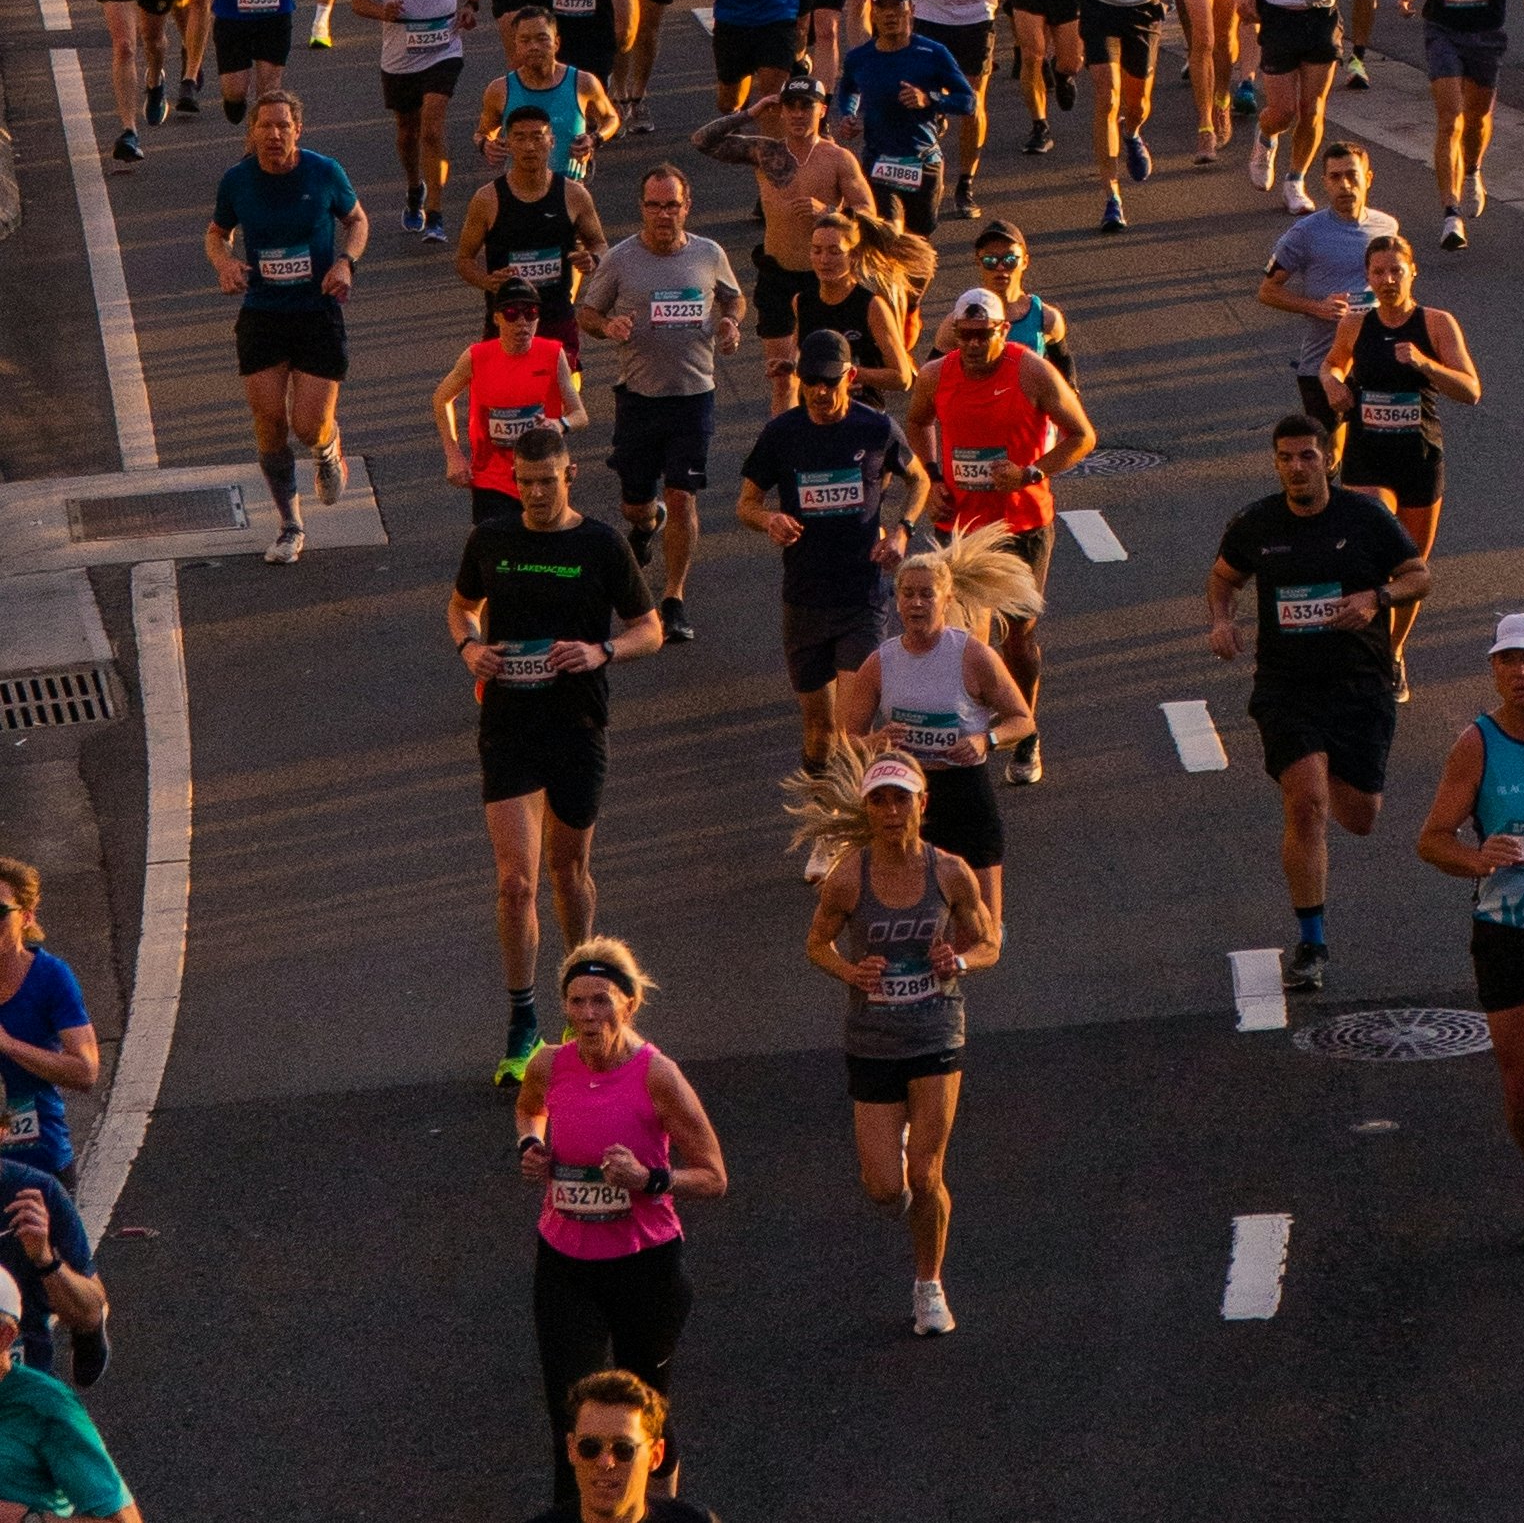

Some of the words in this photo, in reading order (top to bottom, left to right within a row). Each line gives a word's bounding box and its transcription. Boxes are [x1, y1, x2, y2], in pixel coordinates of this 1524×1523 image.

[653, 303, 703, 319] A32233
[495, 421, 535, 437] A3179
[804, 485, 859, 504] A31379
[904, 729, 957, 747] 33849
[554, 1186, 627, 1205] A32784
